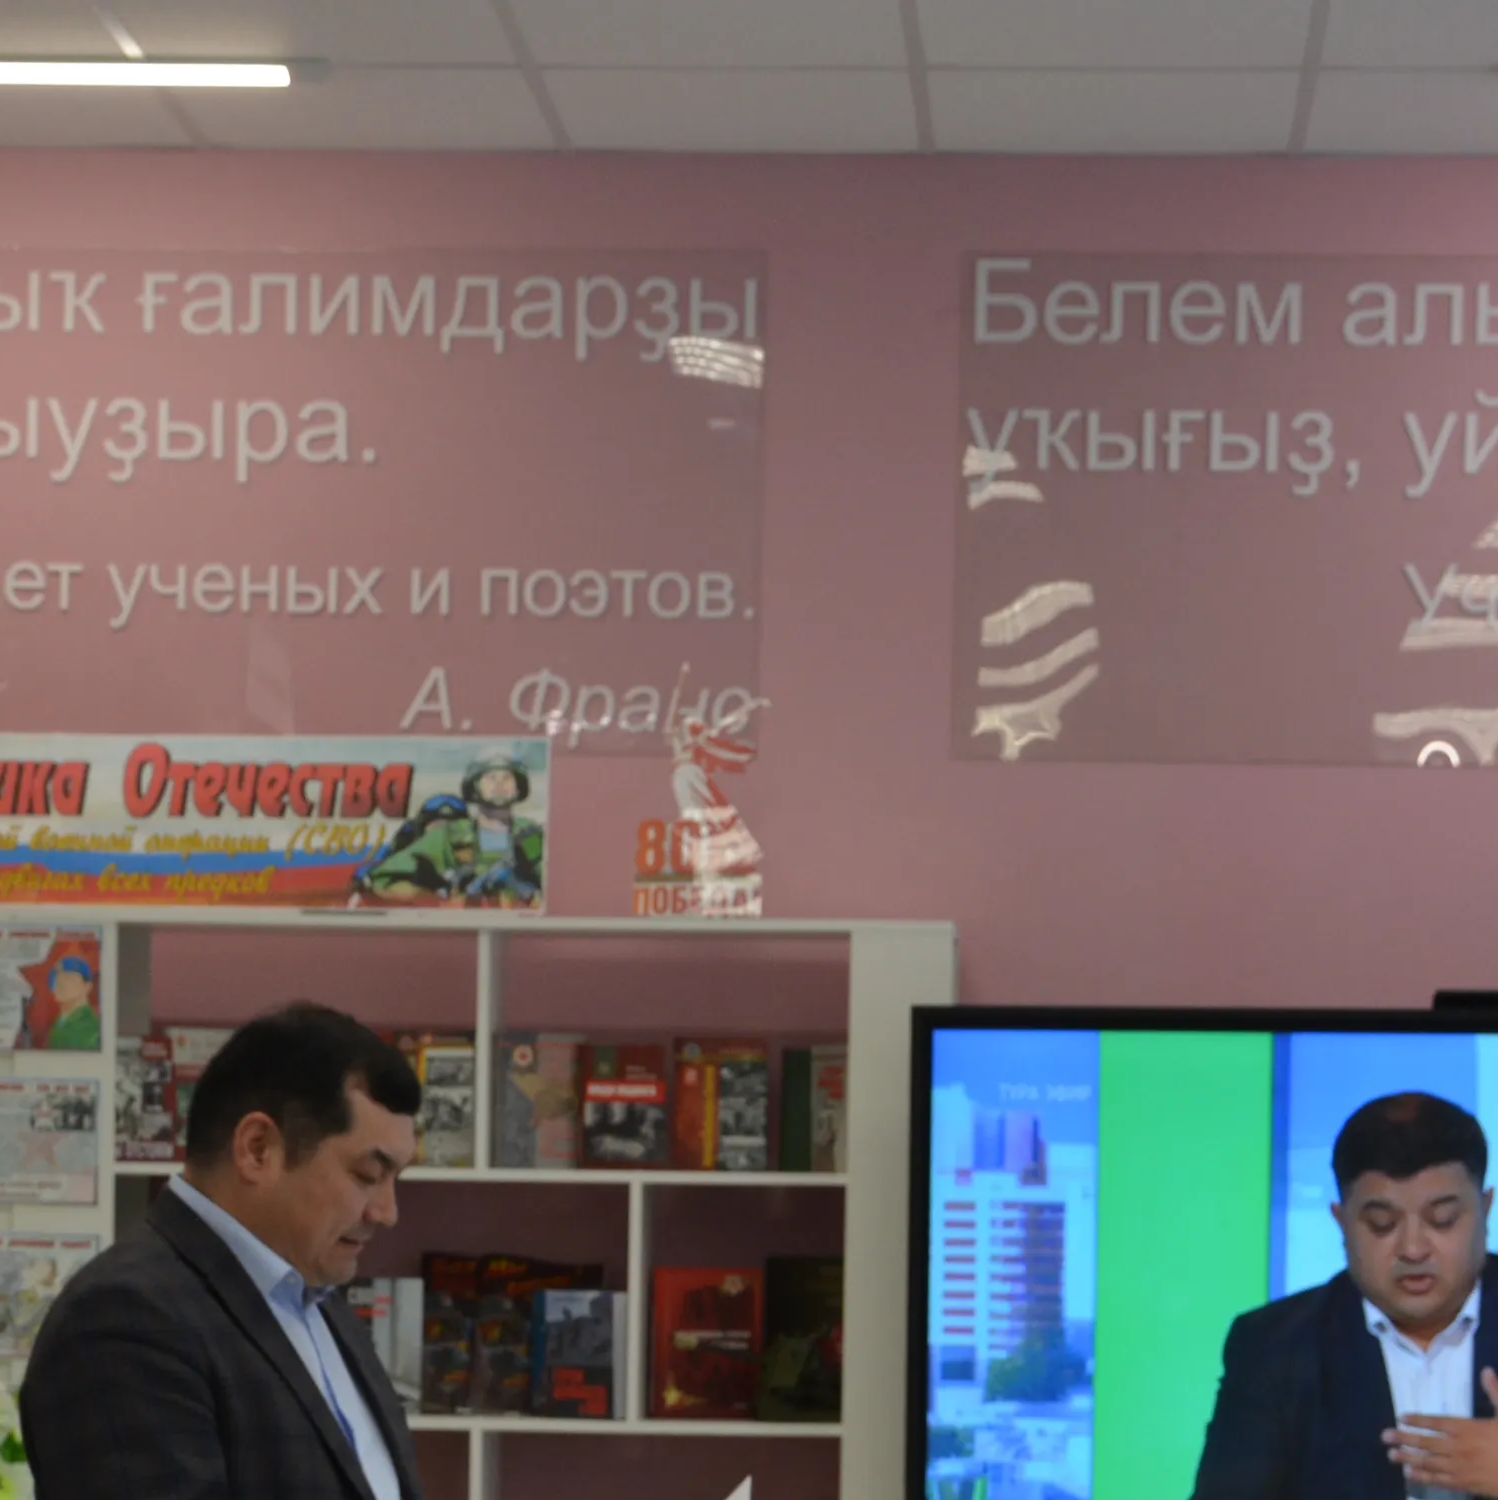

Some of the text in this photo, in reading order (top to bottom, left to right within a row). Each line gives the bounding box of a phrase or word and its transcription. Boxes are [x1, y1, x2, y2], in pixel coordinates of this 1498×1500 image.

[973, 256, 1303, 347] Белем
[107, 560, 383, 629] ученых
[411, 565, 450, 616] и
[480, 567, 758, 621] поэтов.
[400, 665, 473, 732] А.
[124, 742, 416, 821] Отечества
[285, 821, 387, 862] (СВО)
